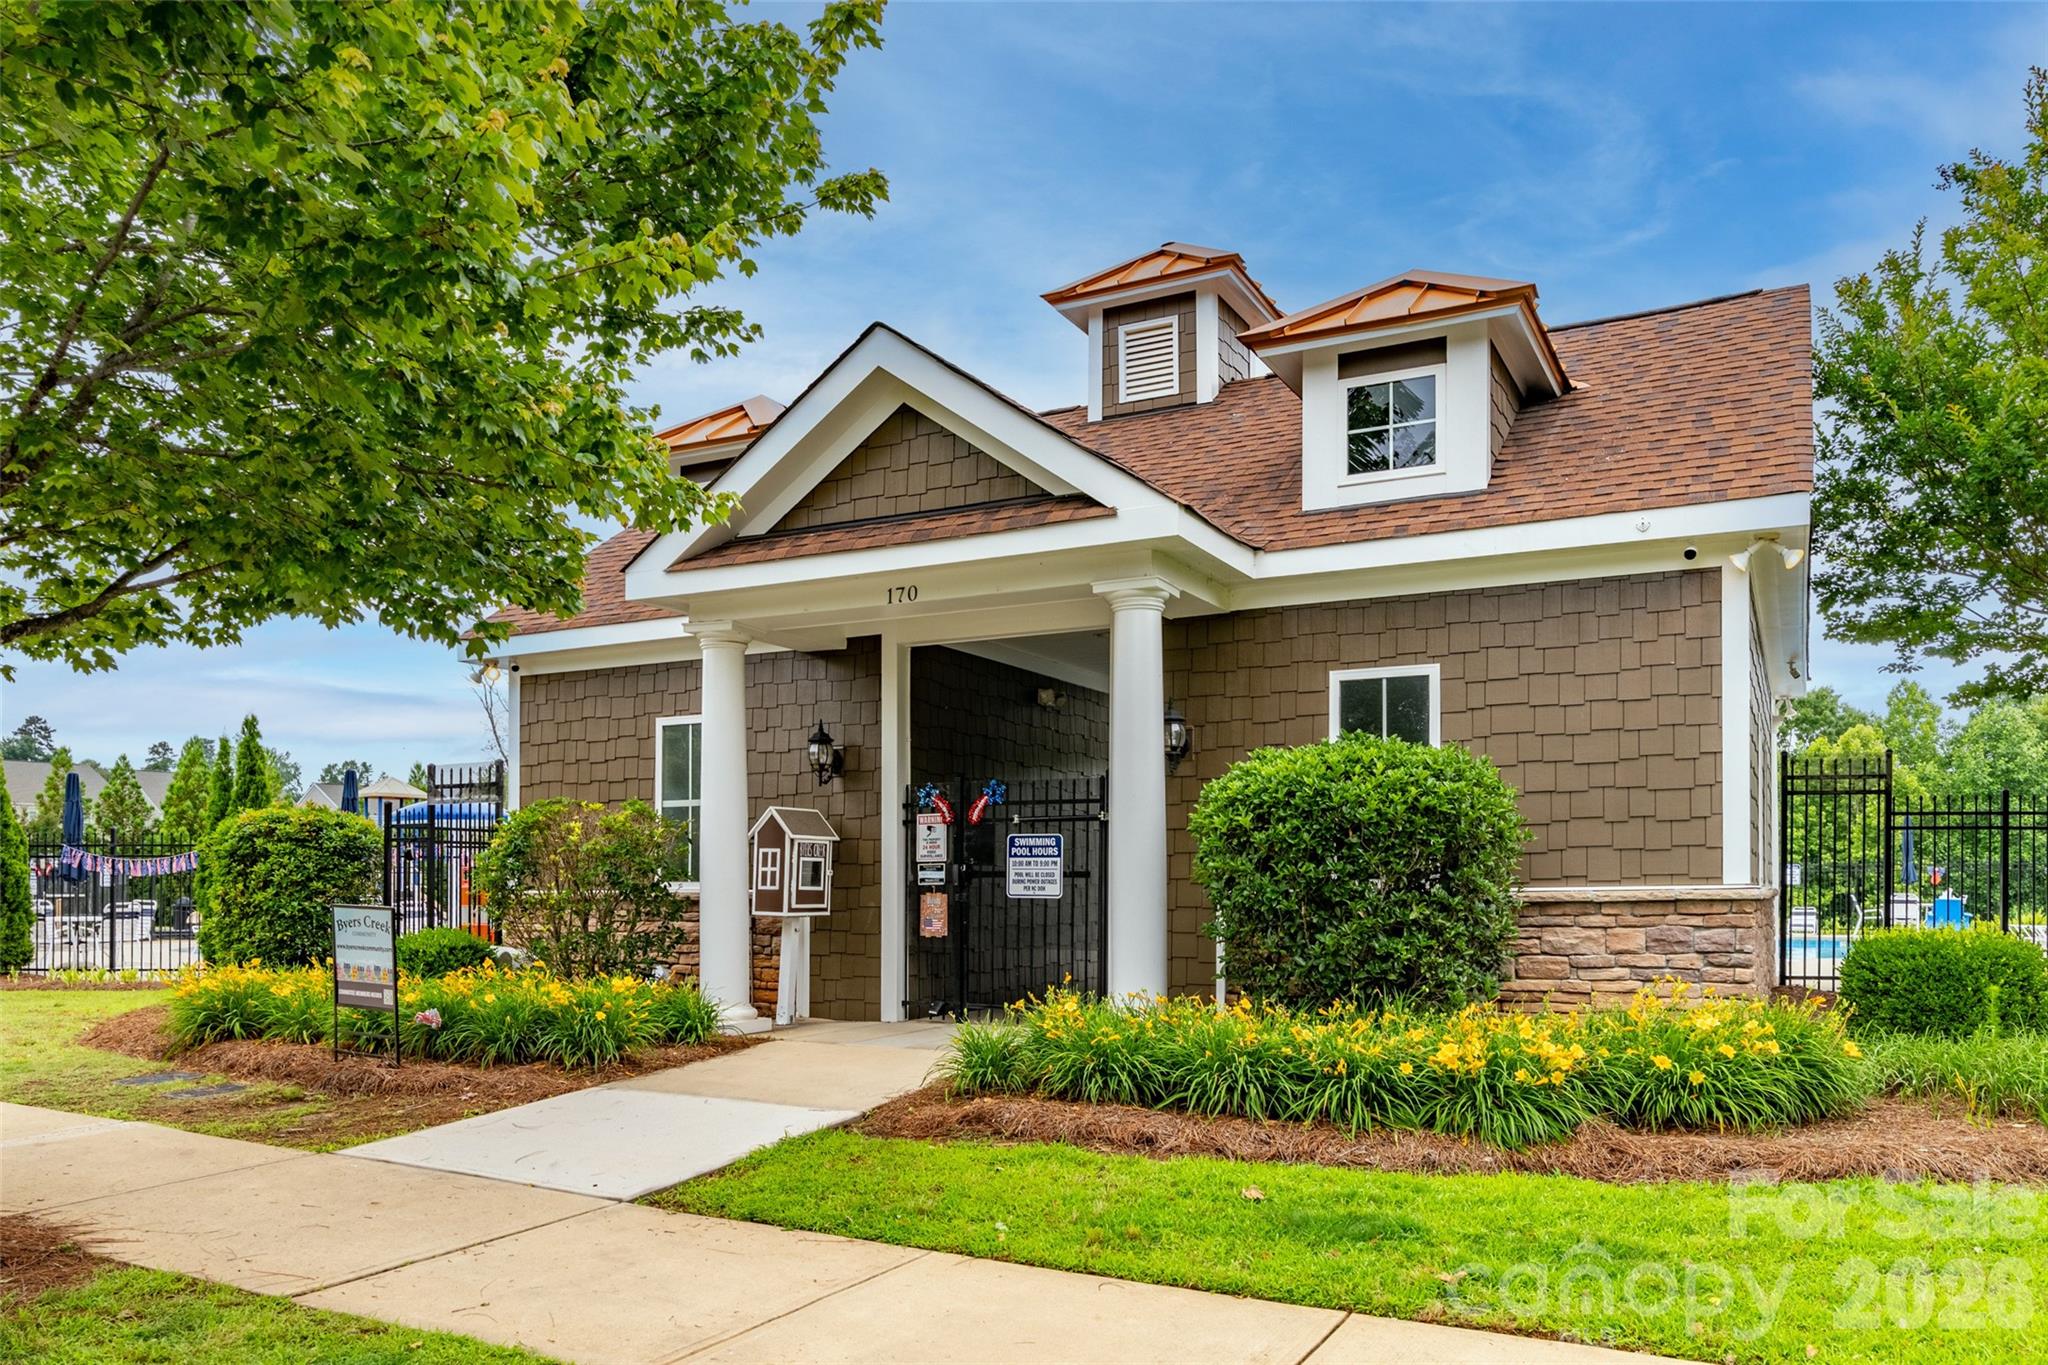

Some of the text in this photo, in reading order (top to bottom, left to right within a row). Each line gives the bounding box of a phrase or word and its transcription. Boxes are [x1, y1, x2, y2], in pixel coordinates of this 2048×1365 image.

[887, 584, 918, 605] 170
[919, 816, 942, 824] WARNIN
[1014, 837, 1056, 846] SWIMMING
[1011, 847, 1059, 856] POOL HOURS
[336, 915, 391, 935] Byers Creek
